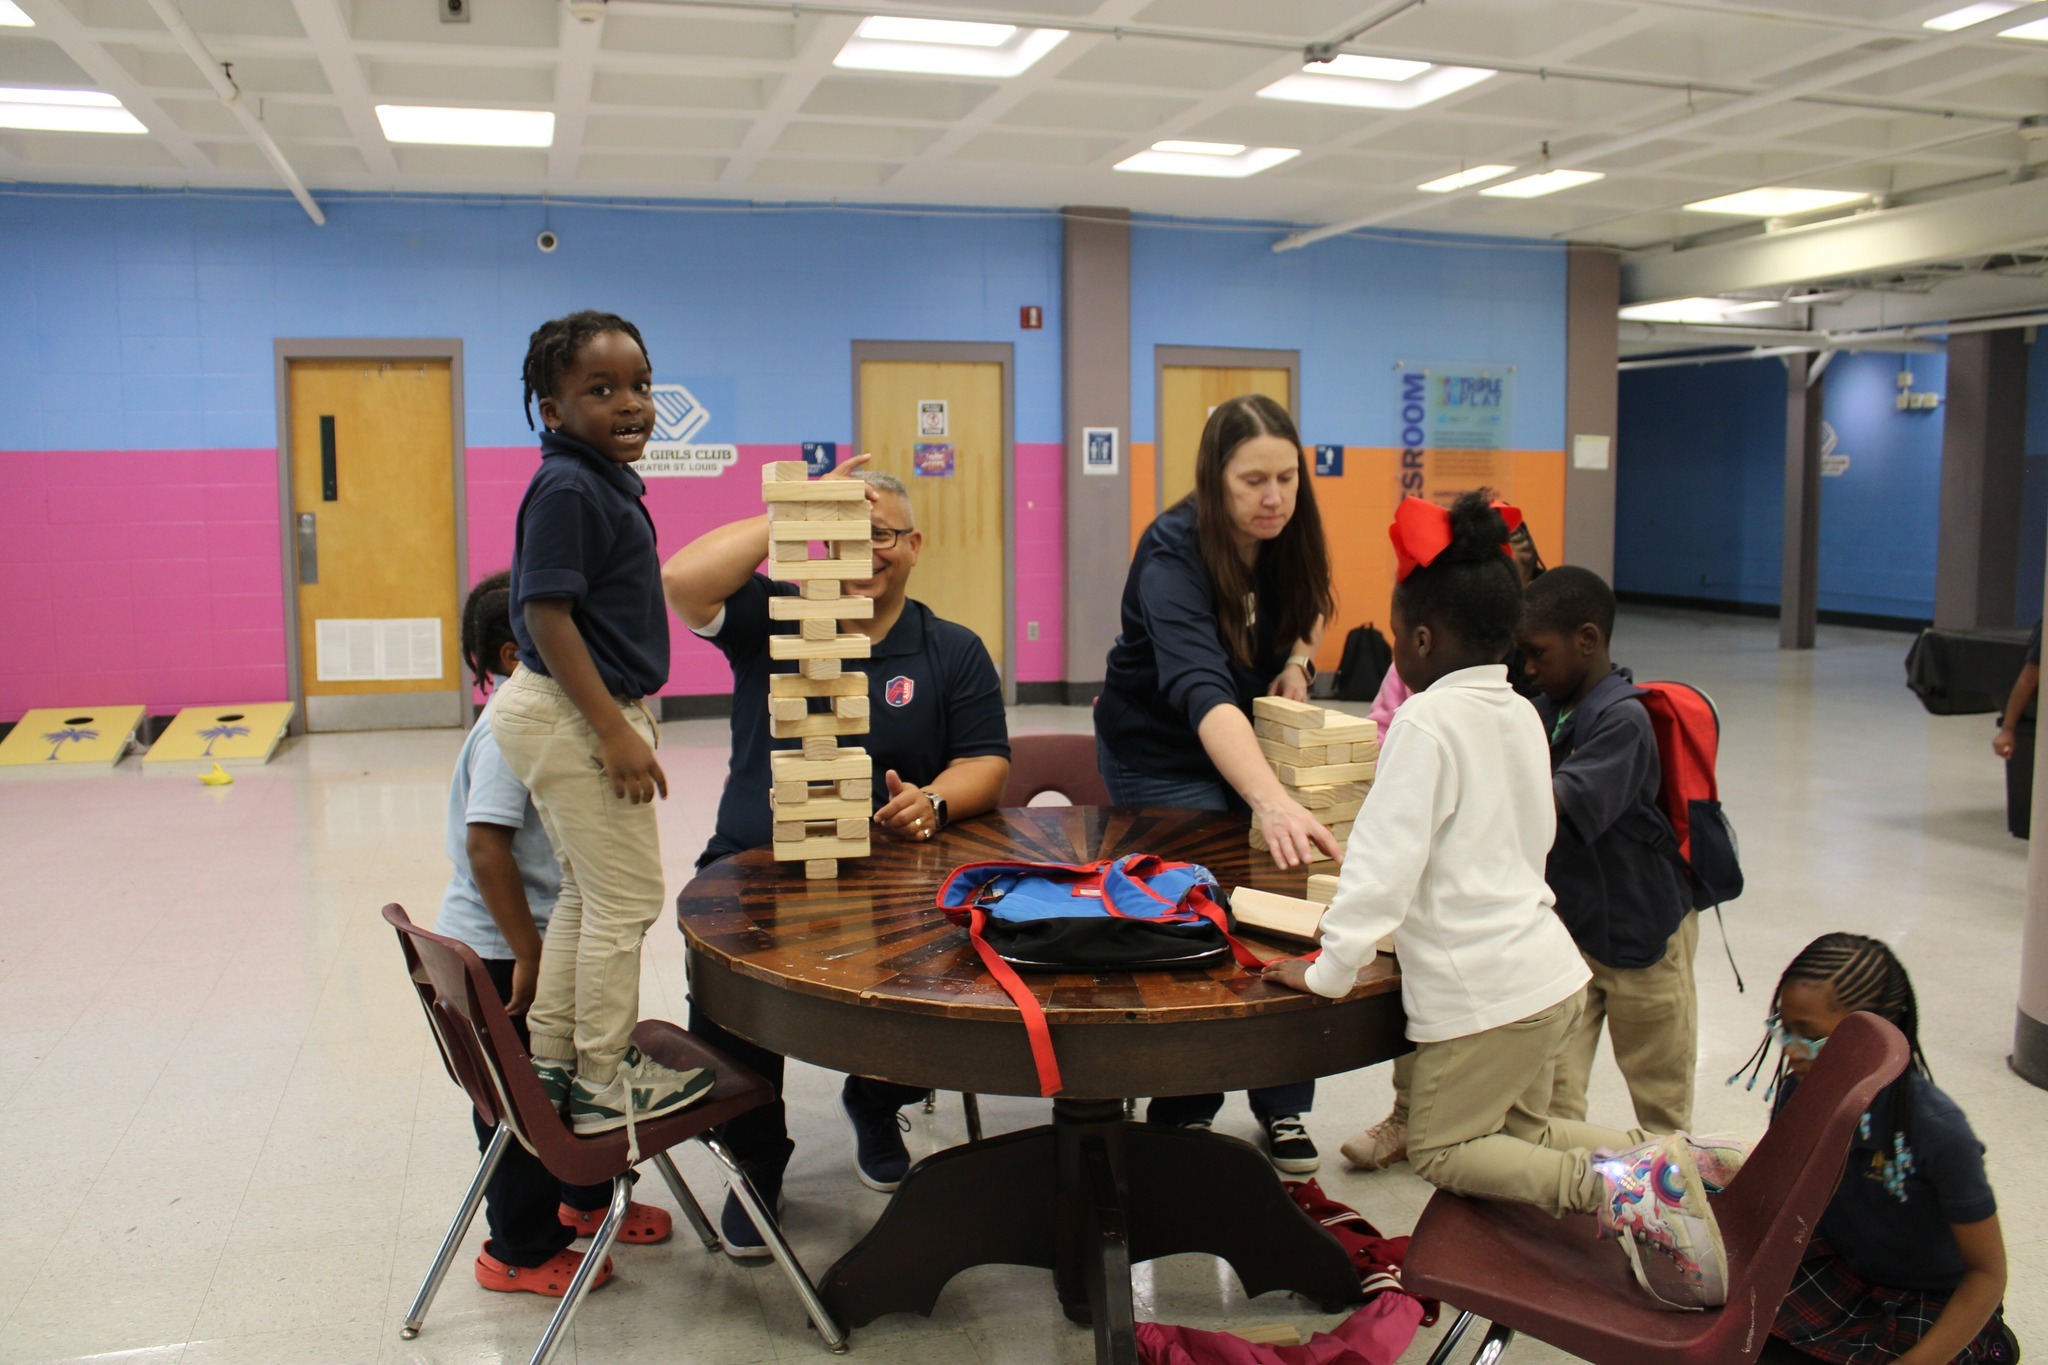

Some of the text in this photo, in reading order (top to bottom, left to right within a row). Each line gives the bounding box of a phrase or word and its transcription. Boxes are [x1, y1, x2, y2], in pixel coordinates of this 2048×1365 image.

[650, 449, 691, 460] GIRLS
[695, 449, 732, 460] CLUB
[629, 463, 717, 471] REATER ST. LOUIS
